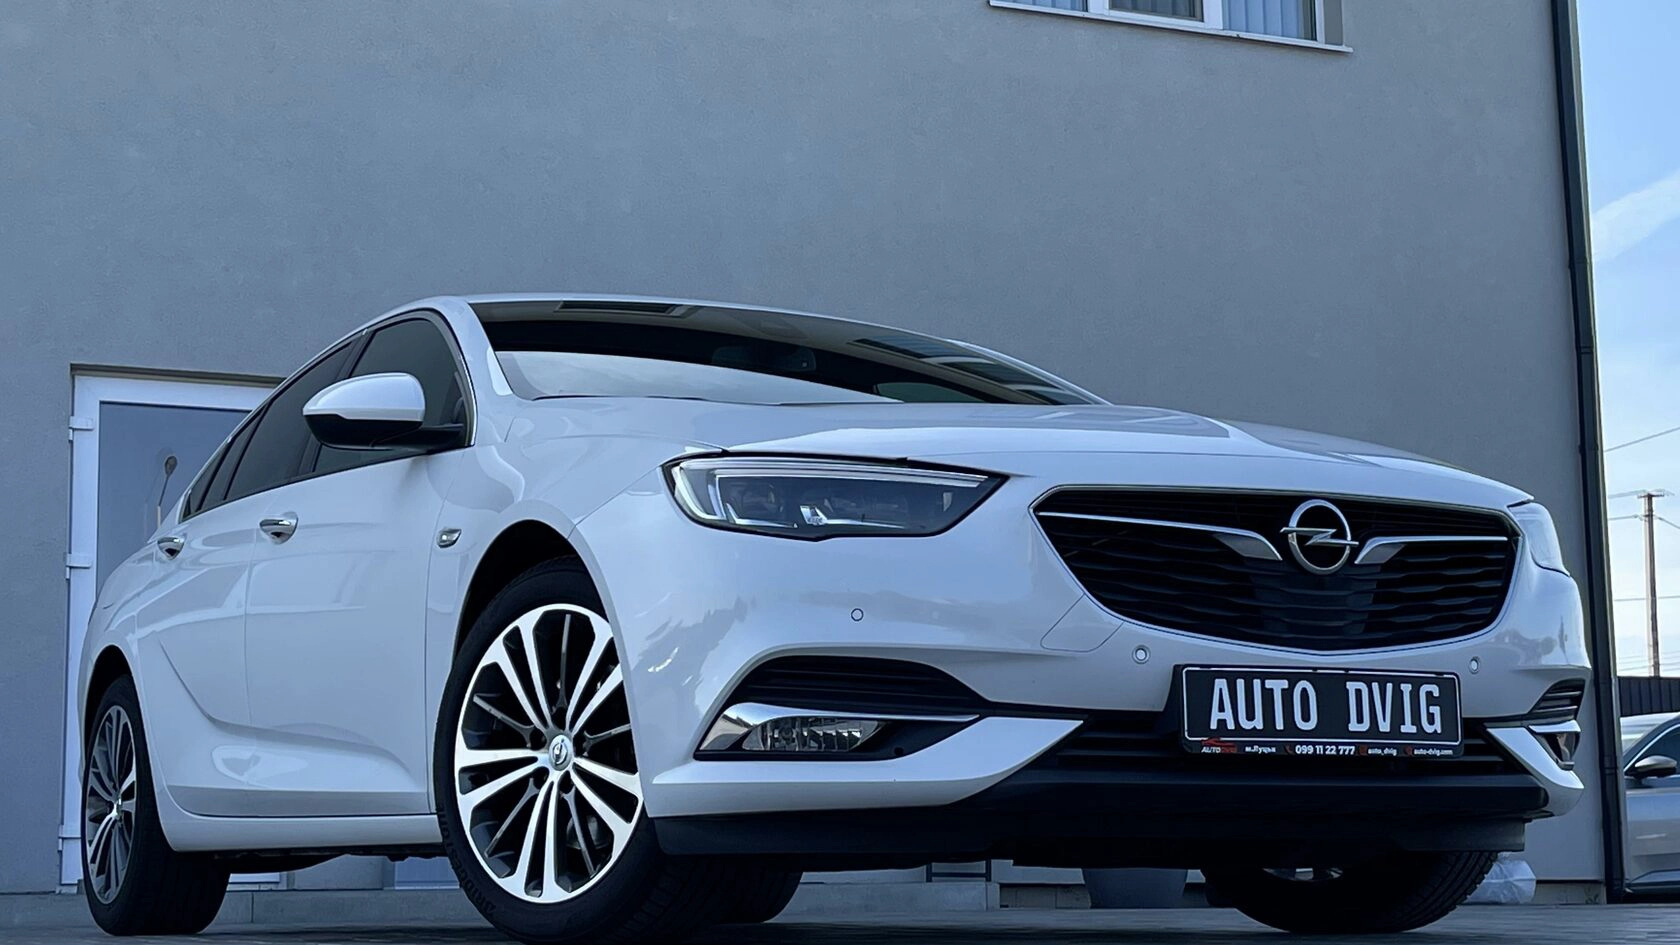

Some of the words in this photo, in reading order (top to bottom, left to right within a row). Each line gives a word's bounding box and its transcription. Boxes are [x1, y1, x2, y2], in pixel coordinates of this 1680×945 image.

[1210, 678, 1318, 731] AUTO
[1346, 681, 1442, 734] DVIG
[1295, 745, 1314, 754] 099
[1315, 745, 1324, 754] 11
[1325, 745, 1337, 755] 22
[1338, 746, 1355, 755] 777
